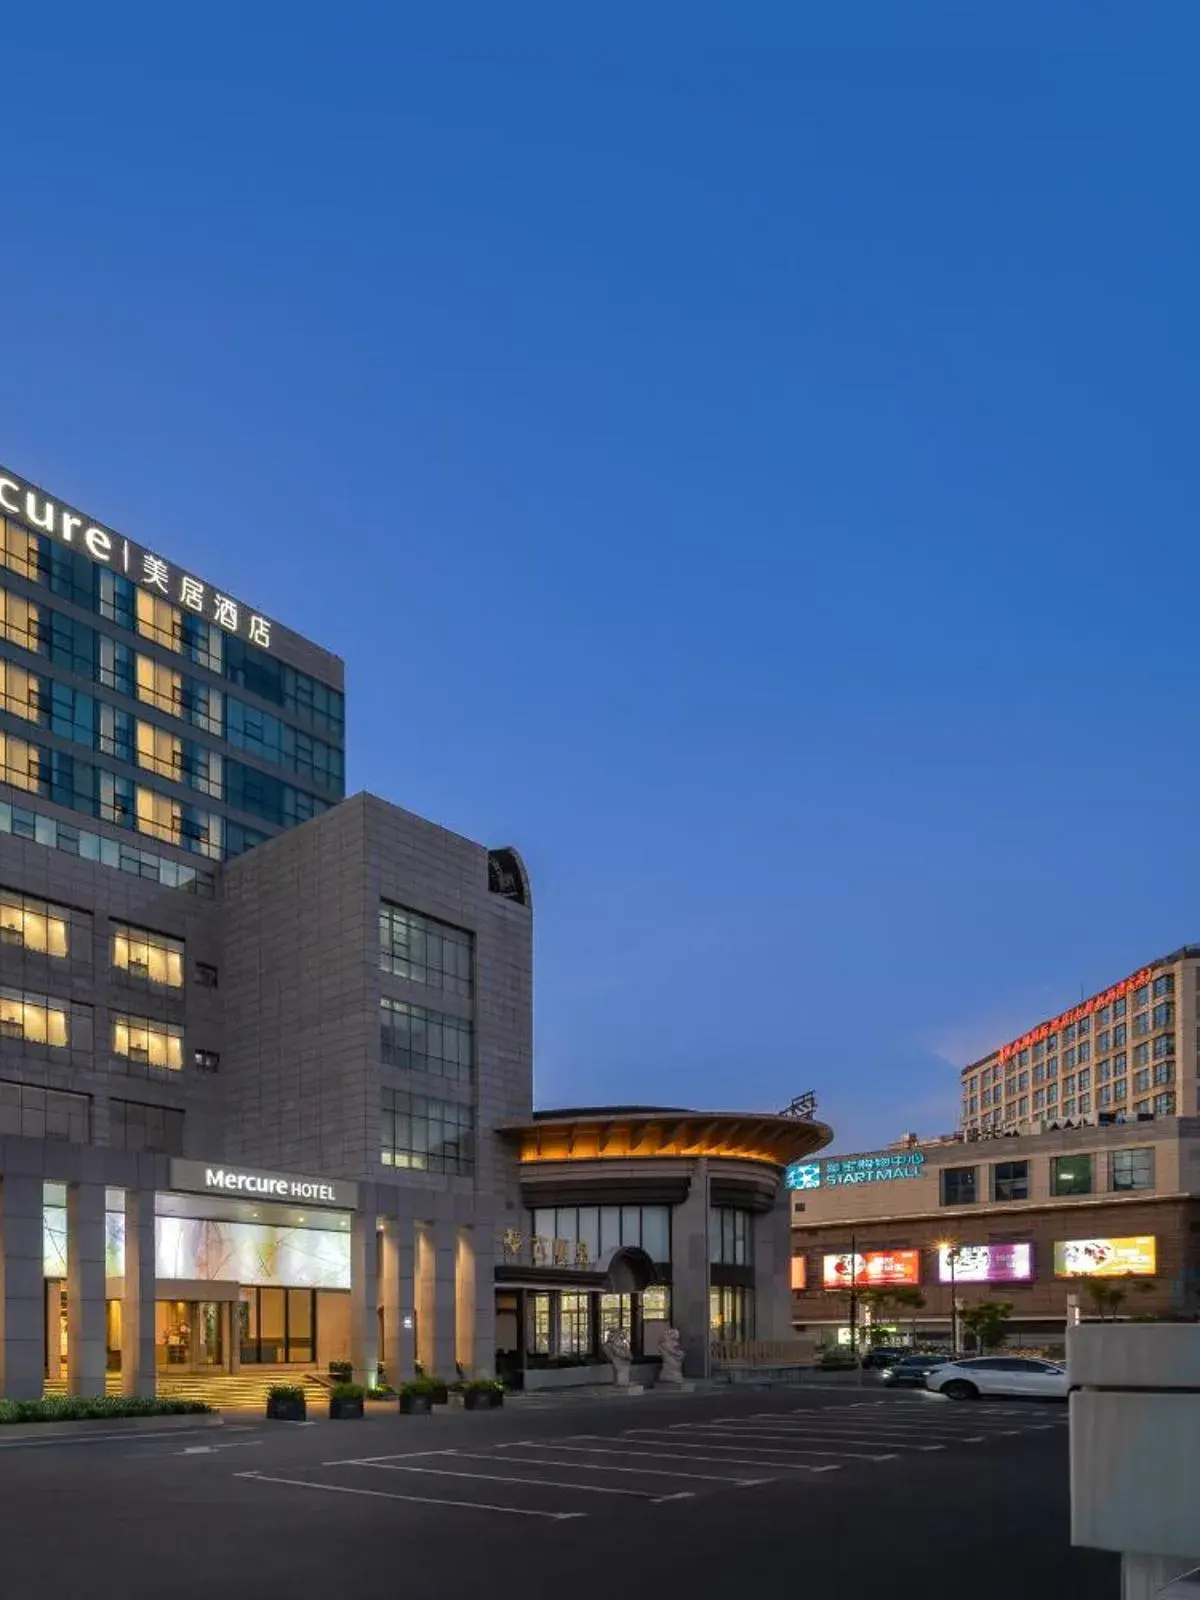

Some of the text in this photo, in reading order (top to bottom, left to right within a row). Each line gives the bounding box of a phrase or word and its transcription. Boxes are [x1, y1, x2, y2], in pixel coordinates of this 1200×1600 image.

[143, 554, 272, 649] 美居酒店
[205, 1168, 336, 1201] Mercure HOTEL
